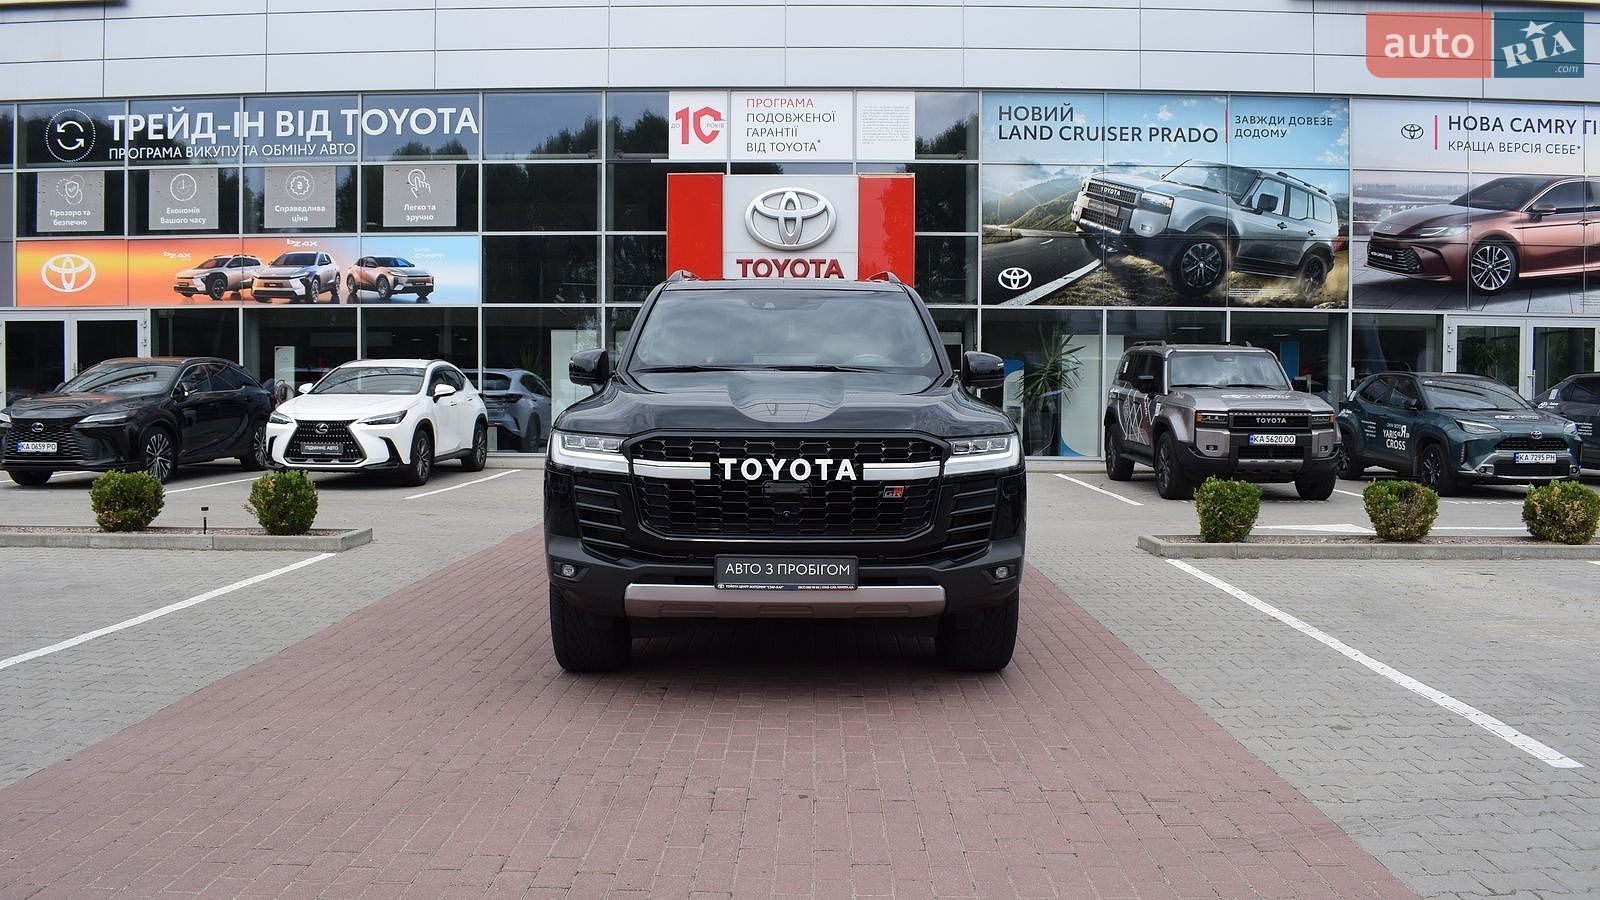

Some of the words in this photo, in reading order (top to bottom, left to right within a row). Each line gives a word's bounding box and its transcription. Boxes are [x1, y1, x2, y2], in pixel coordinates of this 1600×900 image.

[747, 98, 814, 108] ПРОГРАМА
[747, 110, 836, 124] ПОДОВЖЕНОЇ
[998, 103, 1074, 122] НОВИЙ
[108, 106, 264, 145] ТРЕЙД-ІН
[276, 109, 332, 143] ВІД
[341, 107, 479, 136] TOYOTA
[1235, 115, 1285, 126] ЗАВЖДИ
[1288, 116, 1333, 127] ДОВЕЗЕ
[1448, 115, 1504, 132] НОВА
[1510, 117, 1577, 134] CAMRY
[747, 125, 799, 137] ГАРАНТІЇ
[998, 125, 1053, 141] LAND
[1059, 126, 1142, 142] CRUISER
[1149, 127, 1219, 143] PRADO
[1234, 128, 1288, 139] ДОДОМУ
[109, 147, 183, 160] ПРОГРАМА
[186, 146, 240, 158] ВИКУПУ
[243, 145, 258, 157] ТА
[262, 144, 317, 156] ОБМІНУ
[320, 143, 356, 155] АВТО
[747, 142, 766, 153] ВІД
[1448, 141, 1495, 153] КРАЩА
[1499, 142, 1541, 154] ВЕРСІЯ
[50, 209, 81, 217] Прозоро
[274, 205, 326, 213] Справедлива
[403, 204, 427, 212] Легко
[736, 258, 845, 278] TOYOTA
[719, 458, 857, 481] TOYOTA
[725, 563, 761, 575] АВТО
[777, 564, 850, 575] ПРОБІГОМ
